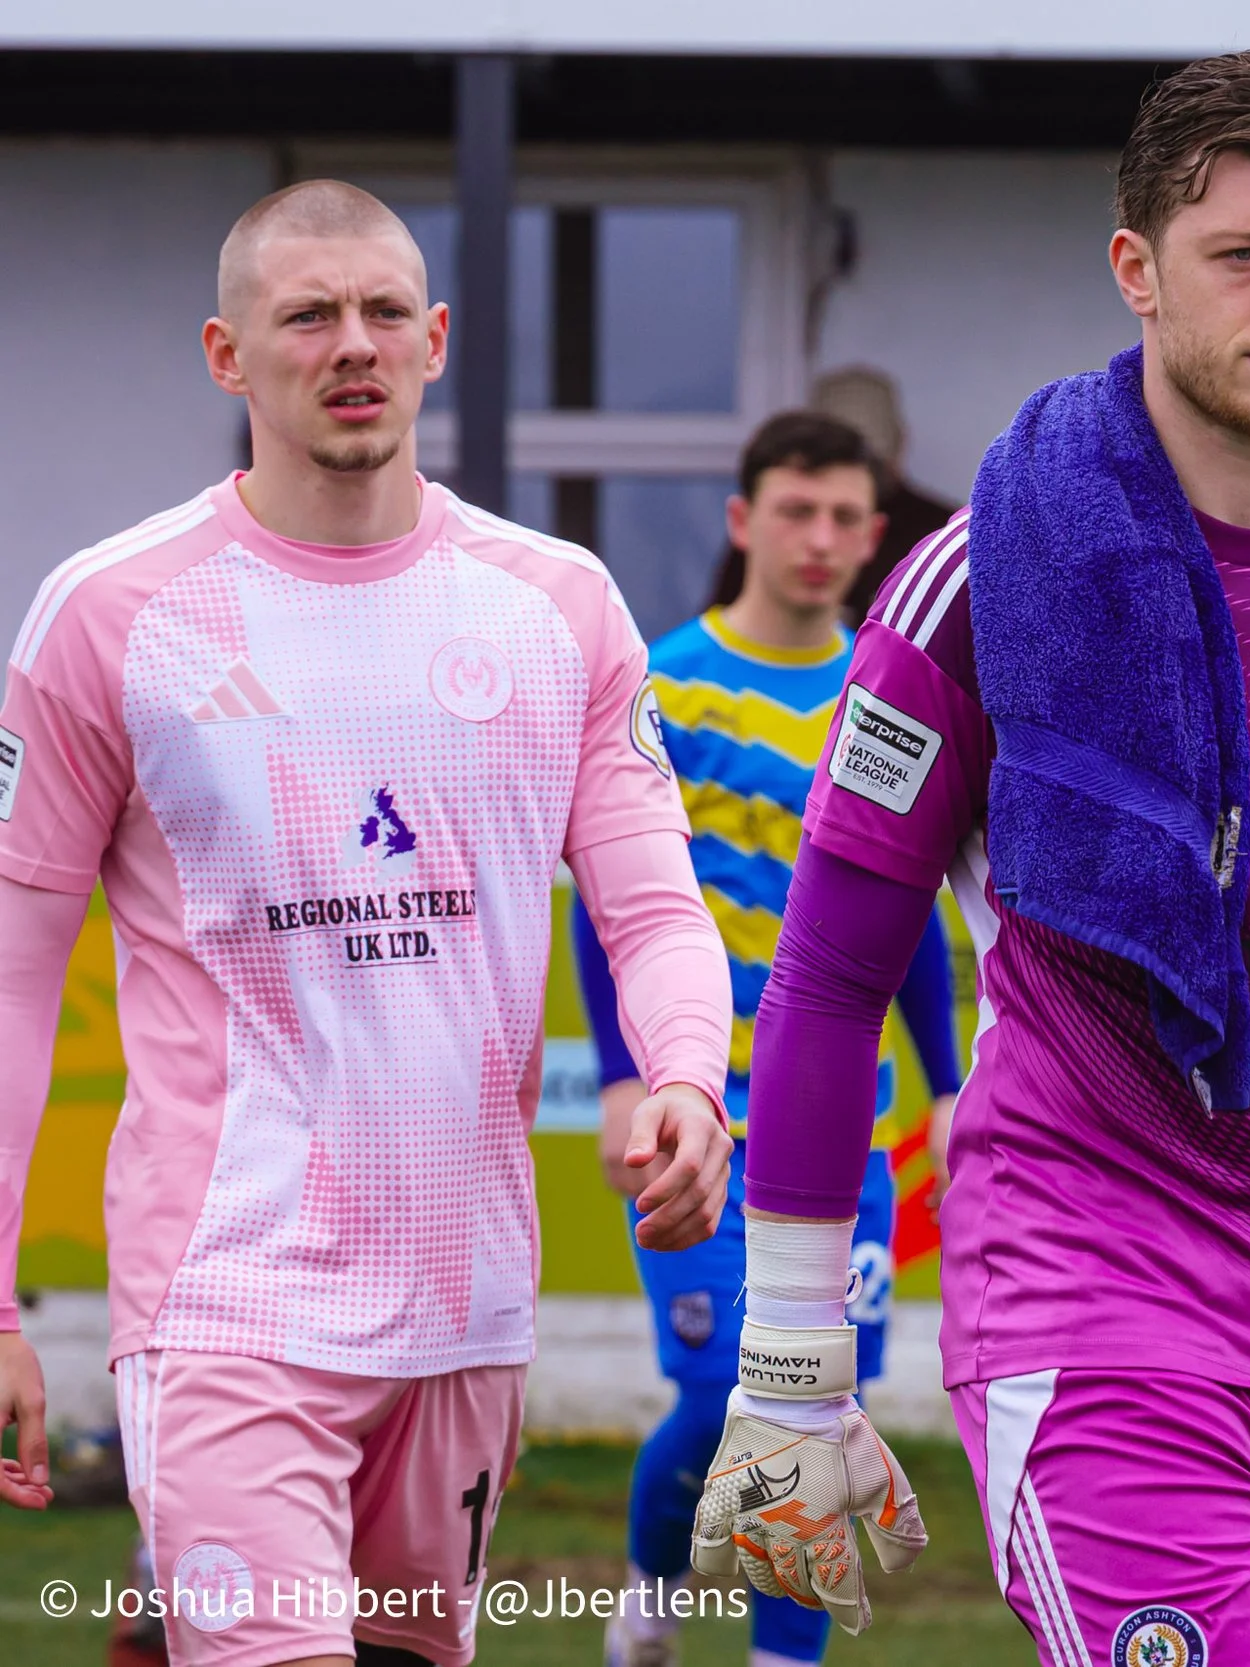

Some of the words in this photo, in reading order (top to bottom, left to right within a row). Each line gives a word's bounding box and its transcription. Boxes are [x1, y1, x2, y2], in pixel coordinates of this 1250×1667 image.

[845, 756, 899, 790] LEAGUE
[847, 743, 909, 783] NATIONAL
[852, 774, 866, 784] EST.
[866, 780, 883, 790] 1979
[265, 893, 392, 931] REGIONAL
[344, 933, 384, 962] UK
[388, 931, 437, 959] LTD.
[740, 1347, 821, 1368] HAWKINS
[740, 1364, 818, 1385] CALLUM
[461, 1469, 498, 1587] 1
[1116, 1617, 1142, 1662] CURZON
[1145, 1610, 1192, 1633] ASHTON
